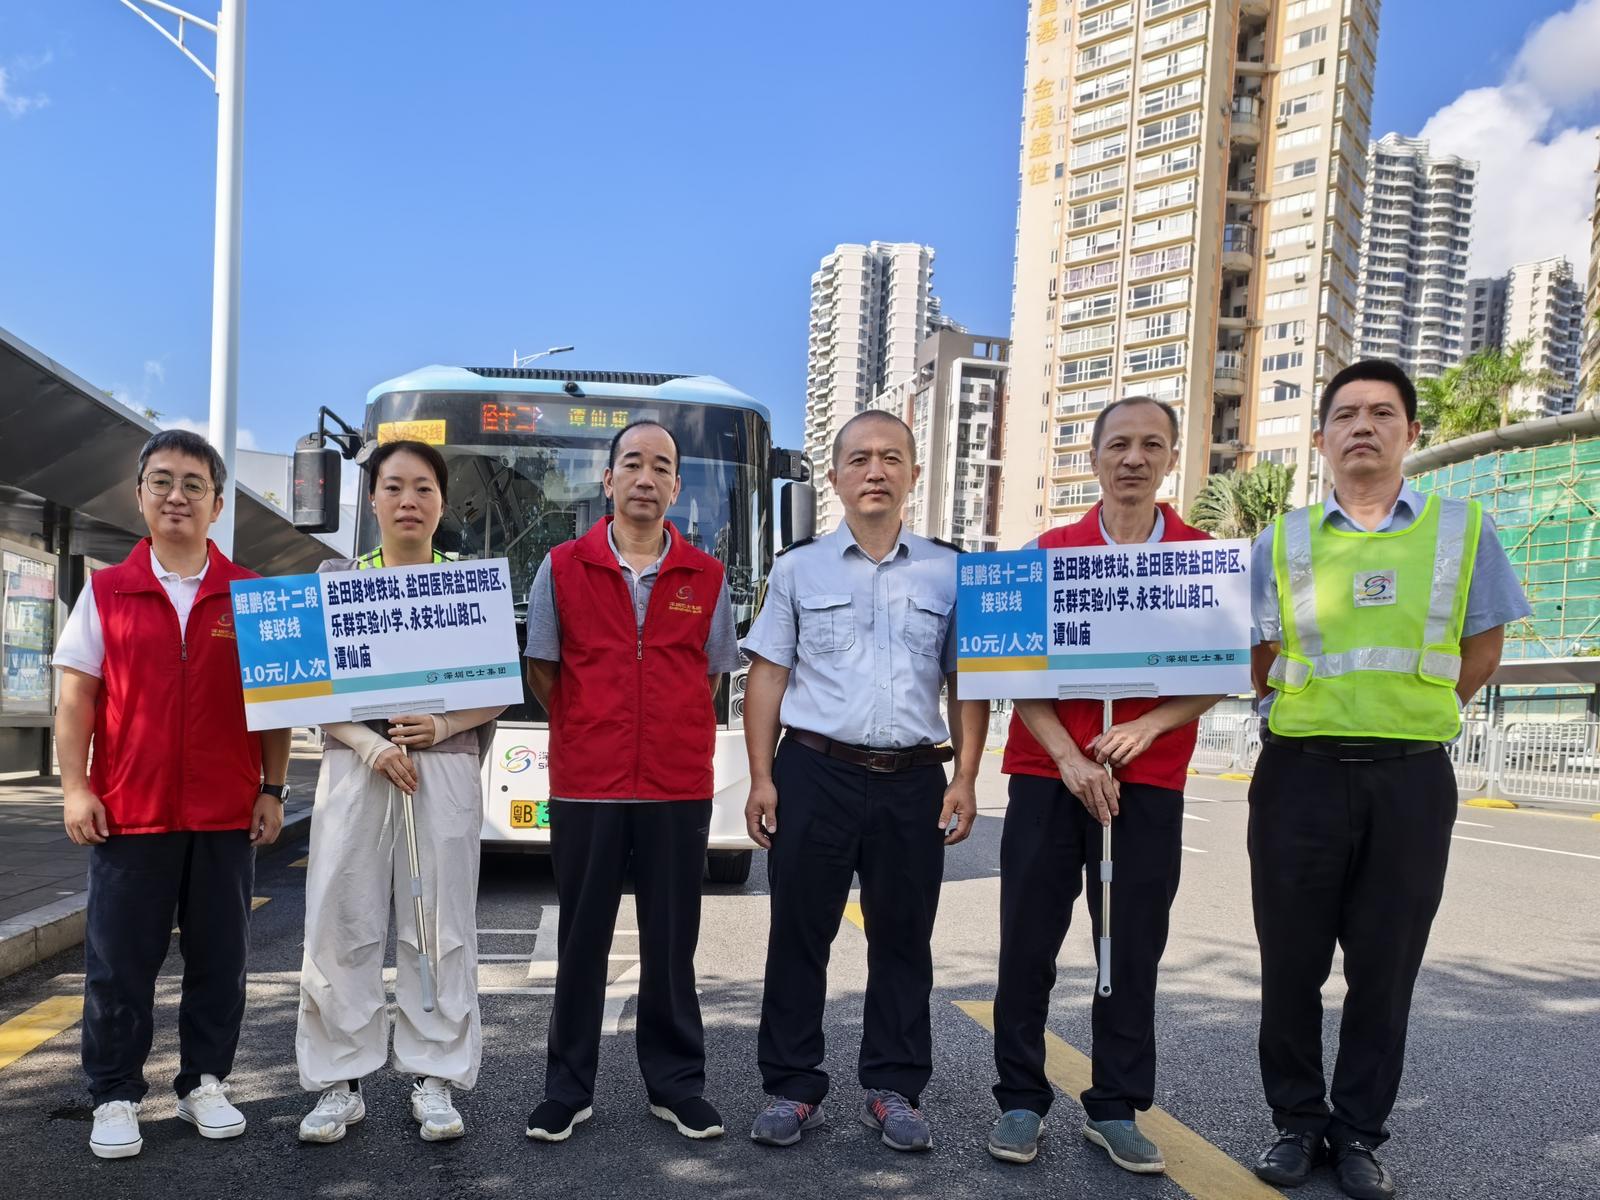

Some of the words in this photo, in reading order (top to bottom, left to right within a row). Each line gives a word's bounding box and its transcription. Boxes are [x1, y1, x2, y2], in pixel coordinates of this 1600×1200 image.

[568, 408, 629, 429] 谭仙庙
[960, 560, 1043, 586] 鲲鹏径十二段
[1053, 548, 1247, 581] 盐田路地铁站、盐田医院盐田院区、
[327, 567, 507, 605] 盐田路地铁站、盐田医院盐田院区、
[1053, 584, 1220, 613] 乐群实验小学、永安北山路口、
[234, 586, 319, 615] 鲲鹏径十二段
[981, 590, 1023, 613] 接驳线
[259, 616, 302, 641] 接驳线
[331, 602, 487, 638] 乐群实验小学、永安北山路口、
[960, 632, 1044, 653] 10元/人次
[1053, 621, 1091, 647] 谭仙庙
[334, 643, 372, 670] 谭仙庙
[1165, 652, 1235, 663] 深圳巴士集团
[243, 658, 327, 683] 10元/人次
[443, 666, 507, 680] 深圳巴士集团
